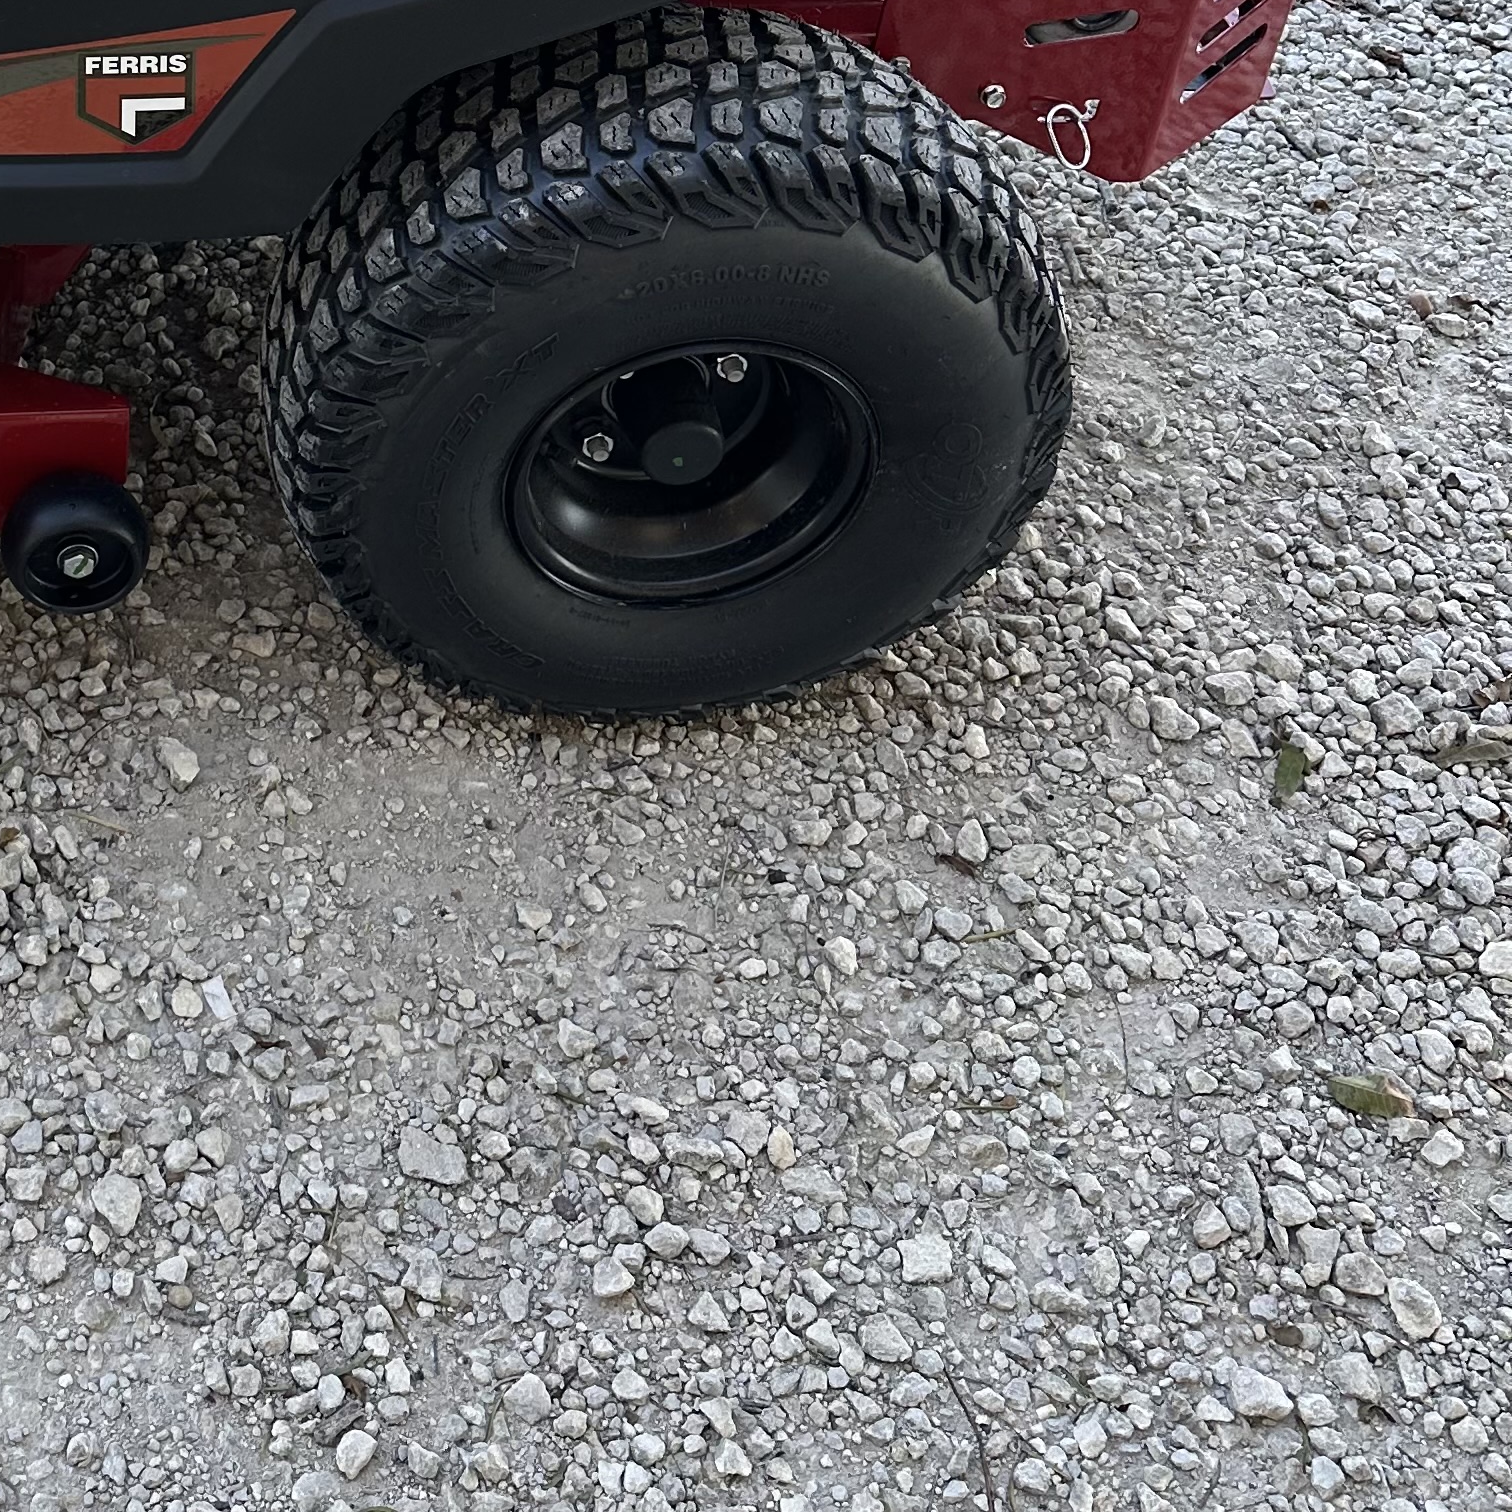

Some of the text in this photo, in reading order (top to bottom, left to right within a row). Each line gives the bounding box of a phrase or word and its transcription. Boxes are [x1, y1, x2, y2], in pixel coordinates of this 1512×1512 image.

[85, 54, 187, 75] FERRIS
[778, 264, 832, 288] NHS
[414, 391, 496, 561] MASTER
[484, 330, 561, 393] XT
